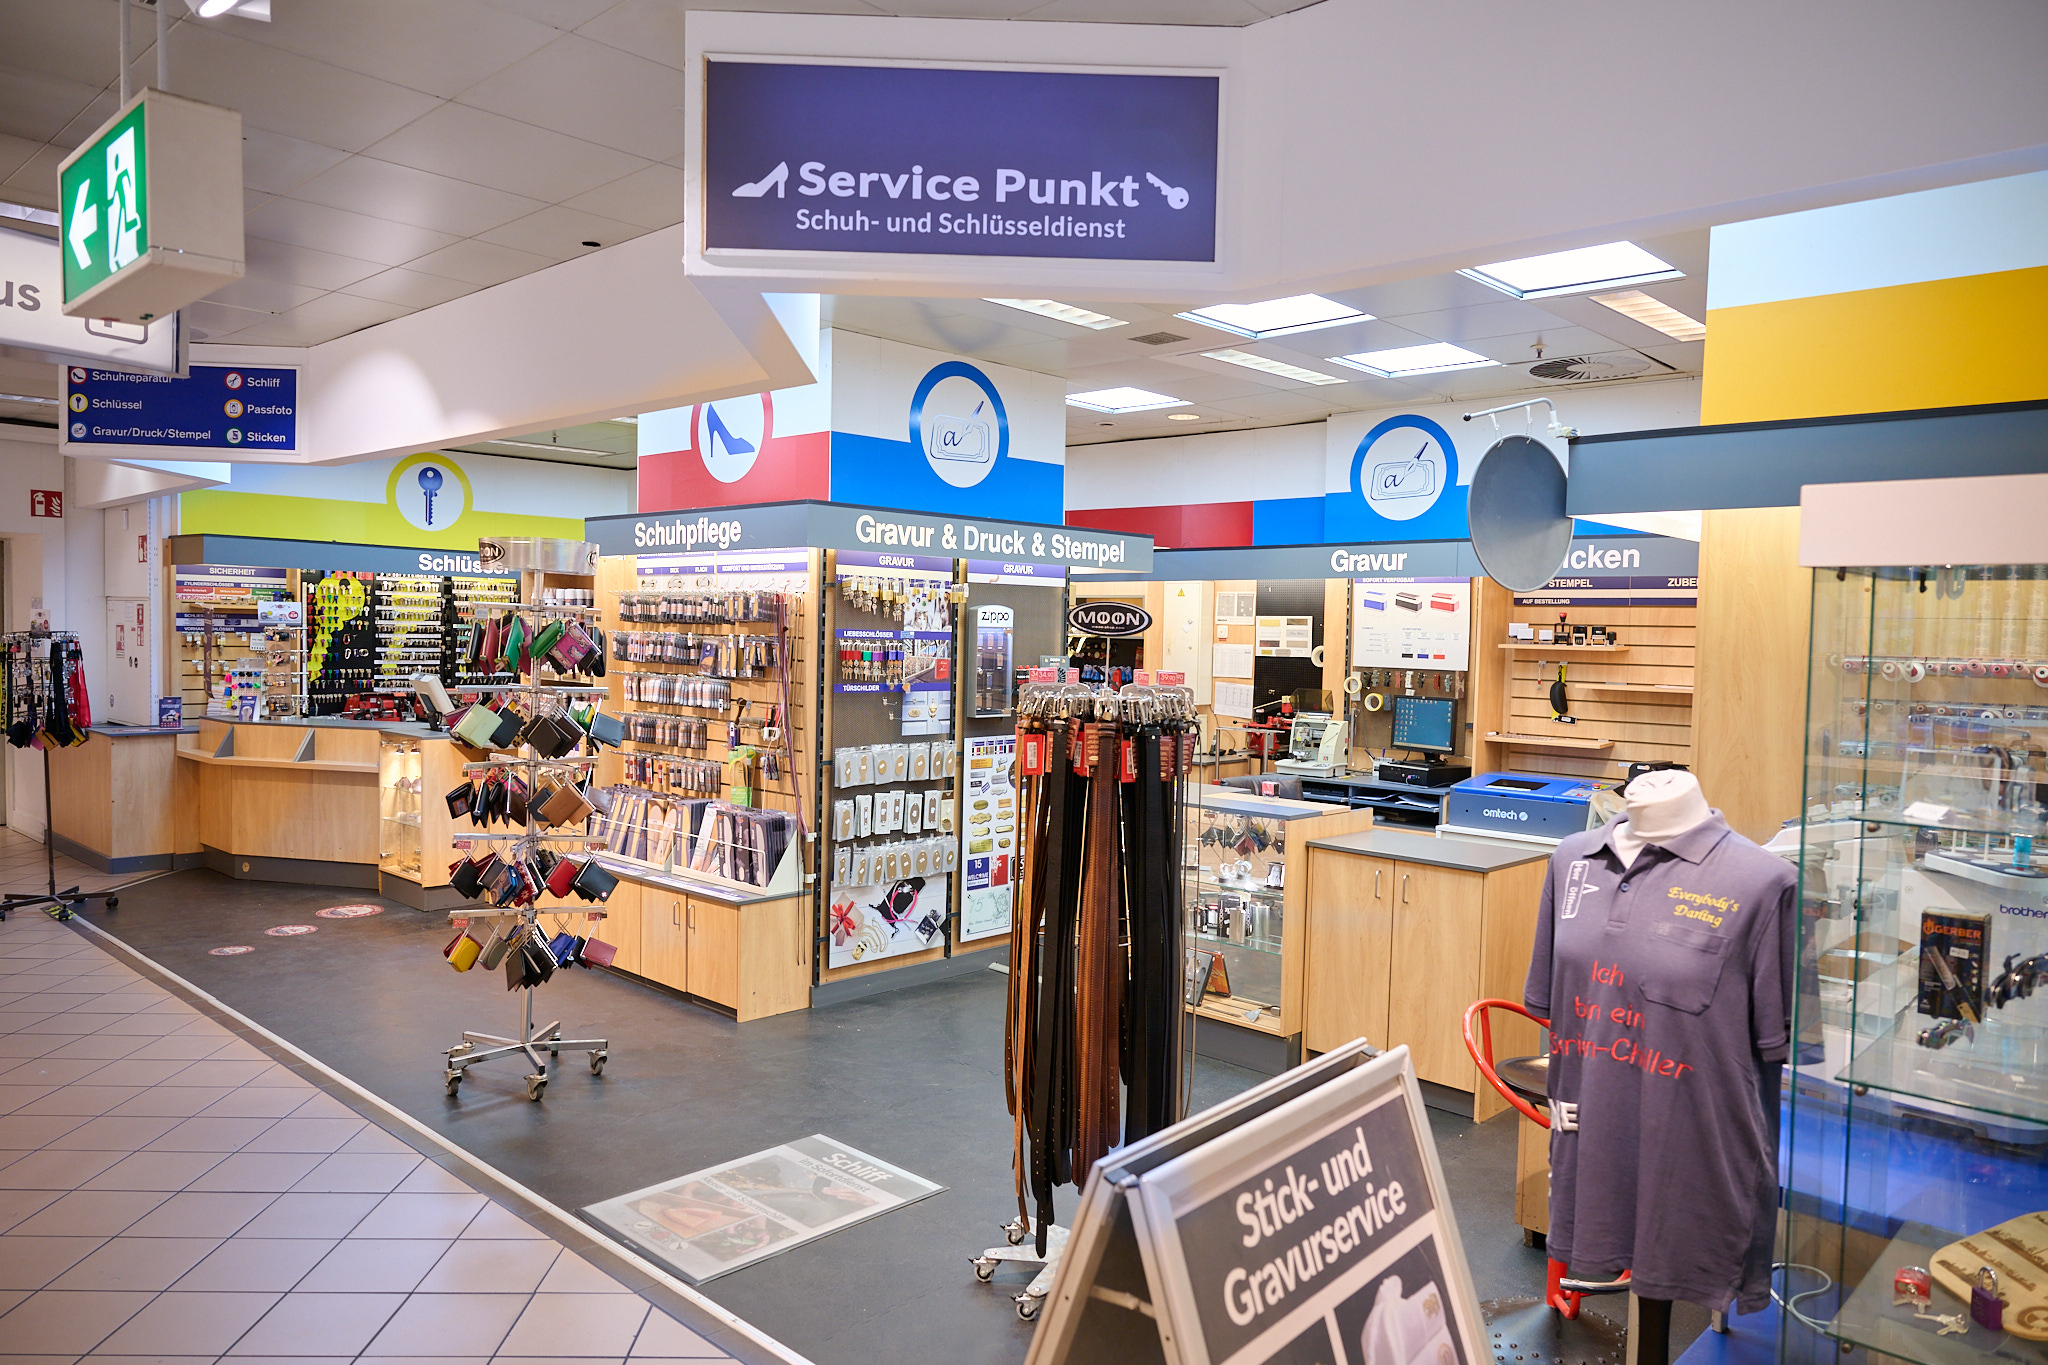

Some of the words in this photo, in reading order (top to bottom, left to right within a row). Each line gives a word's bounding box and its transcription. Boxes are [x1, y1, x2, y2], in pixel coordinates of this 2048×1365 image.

[798, 161, 980, 202] Service
[996, 168, 1140, 208] Punkt
[795, 208, 880, 232] Schuh-
[886, 211, 933, 234] und
[937, 213, 1126, 239] Schlüsseldienst
[247, 376, 281, 388] Schliff
[92, 398, 143, 410] Schlüssel
[247, 404, 293, 416] Passfoto
[92, 426, 211, 441] Gravur/Druck/Stempel
[247, 432, 286, 443] Sticken
[633, 517, 742, 550] Schuhpflege
[855, 515, 935, 550] Gravur
[941, 523, 957, 550] &
[963, 528, 1026, 557] Druck
[1031, 532, 1046, 557] &
[1050, 535, 1125, 567] Stempel
[879, 555, 915, 568] GRAVUR
[1330, 549, 1408, 573] Gravur
[209, 567, 256, 576] SICHERHEIT
[1003, 563, 1034, 575] GRAVUR
[1548, 578, 1593, 588] STEMPEL
[1667, 577, 1698, 587] ZUBE
[1077, 610, 1141, 626] MOON
[843, 630, 894, 638] LIEBESSCHLÖSSER
[1161, 673, 1176, 681] 39.90
[842, 684, 880, 692] TÜRSCHILDER
[1483, 808, 1518, 821] omtech
[974, 859, 982, 869] 15
[1667, 886, 1740, 913] Everybody's
[1673, 904, 1723, 928] Darling
[1935, 925, 1982, 939] GERBER
[1591, 960, 1624, 987] Ich
[1610, 1004, 1645, 1030] ein
[822, 1152, 894, 1183] Schliff
[812, 1163, 871, 1193] Sofortdienst
[1236, 1165, 1320, 1247] Stick-
[1320, 1126, 1373, 1196] und
[1223, 1180, 1407, 1326] Gravurservice
